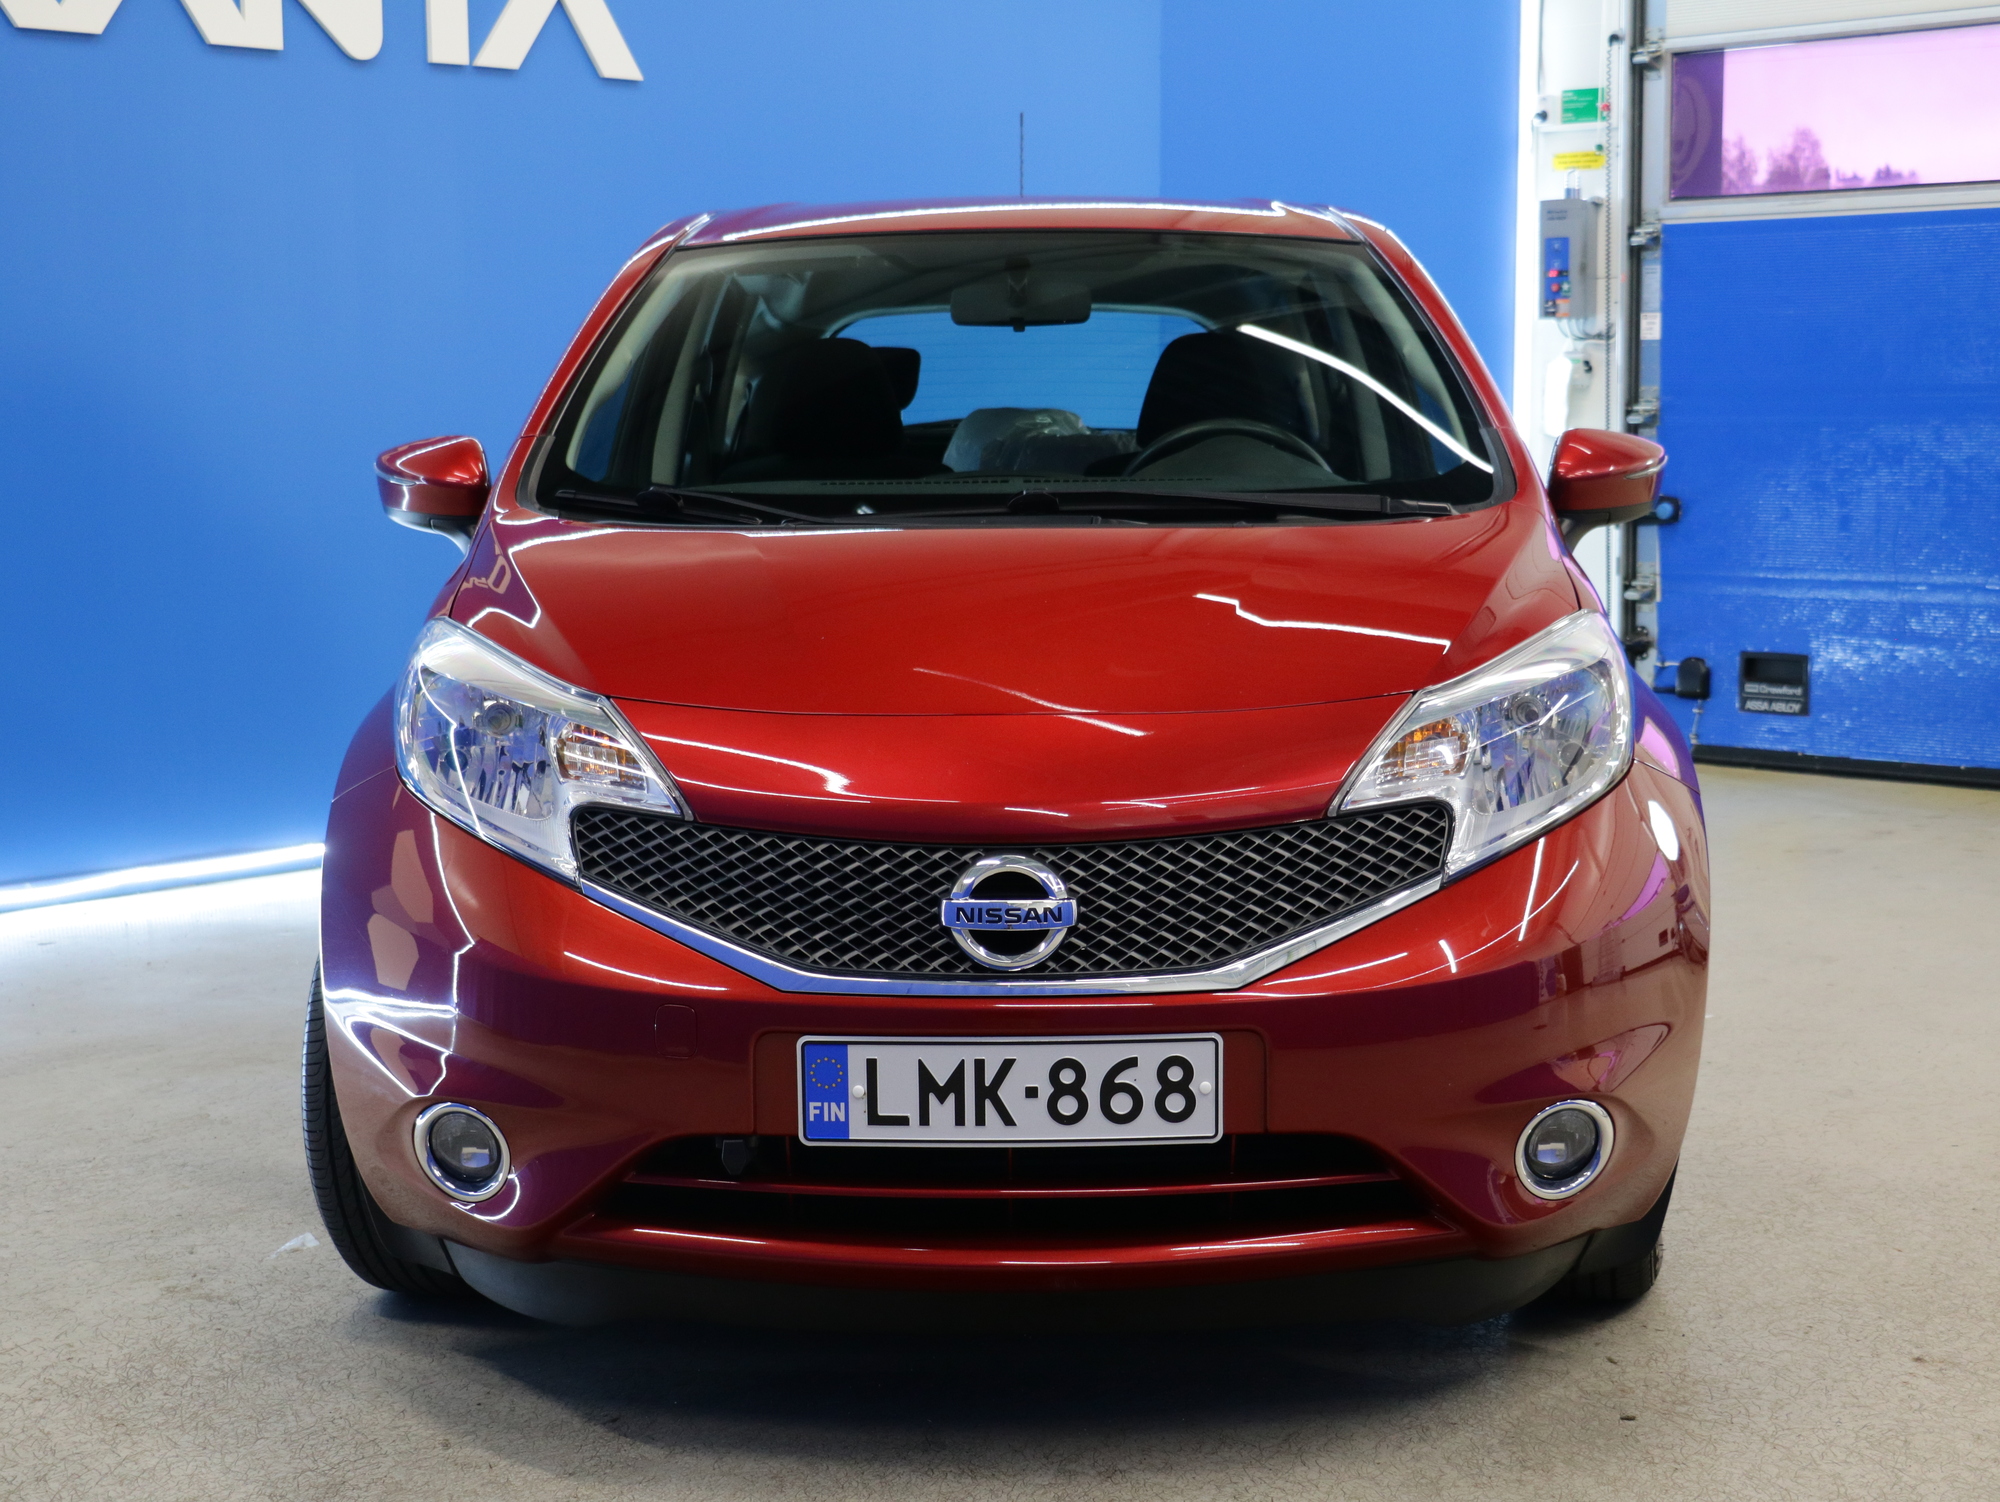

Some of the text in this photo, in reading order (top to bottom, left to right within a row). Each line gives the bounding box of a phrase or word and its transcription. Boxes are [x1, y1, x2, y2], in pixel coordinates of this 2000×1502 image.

[1760, 684, 1802, 696] Crawford
[1745, 700, 1802, 713] ASSA ABLOY
[955, 906, 1062, 924] NISSAN
[866, 1055, 1197, 1127] LMK-868
[808, 1101, 846, 1122] FIN
